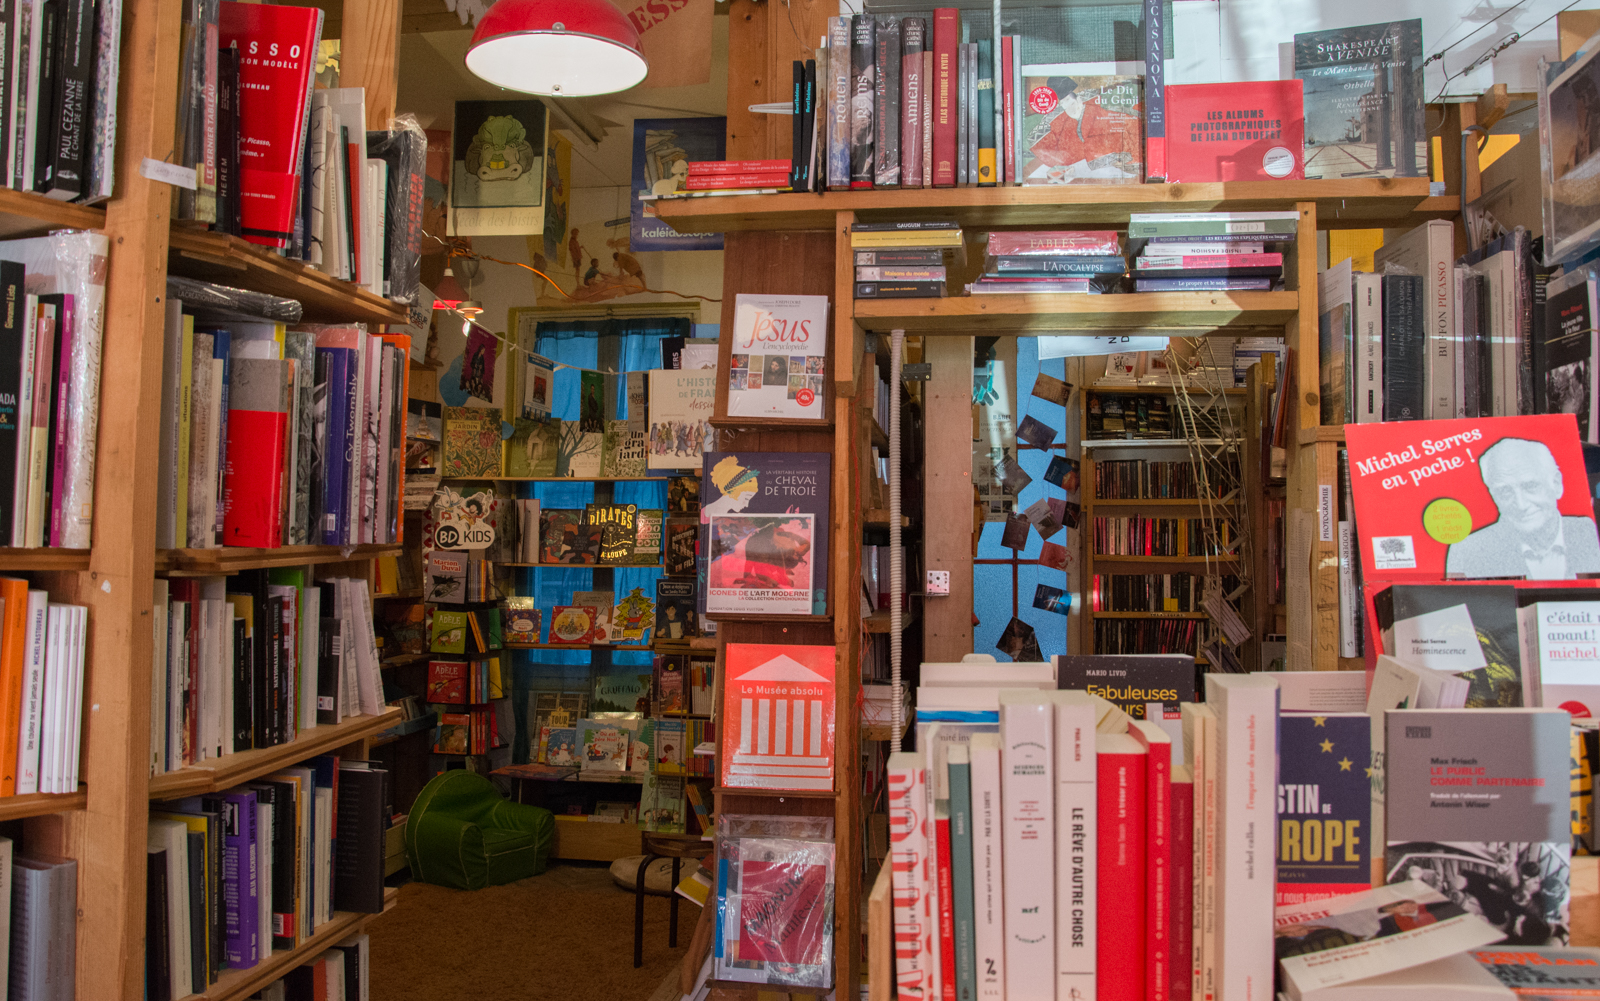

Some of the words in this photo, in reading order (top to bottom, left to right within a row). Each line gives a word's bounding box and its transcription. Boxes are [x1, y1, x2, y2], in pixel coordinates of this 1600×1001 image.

[626, 0, 690, 35] ESS
[1150, 6, 1161, 98] CASANOVA
[1317, 36, 1399, 53] SHAKESPEARE
[1334, 47, 1390, 60] VENISE
[1324, 64, 1367, 76] Marchand
[1380, 60, 1406, 70] Venise
[74, 80, 83, 100] TERRE
[940, 78, 948, 107] HISTORIQUE
[1100, 85, 1114, 96] Le
[1116, 84, 1134, 96] Dit
[1343, 81, 1375, 90] Othello
[62, 78, 76, 132] CEZANNE
[74, 102, 82, 111] LA
[206, 84, 215, 125] TABLEAU
[1094, 94, 1107, 106] du
[1111, 94, 1139, 107] Genji
[74, 112, 81, 122] DE
[940, 108, 948, 124] ATLAS
[1207, 111, 1223, 120] LES
[1226, 109, 1264, 120] ALBUMS
[1190, 120, 1282, 132] PHOTOGRAPHIQUES
[72, 124, 80, 150] CHANT
[1190, 132, 1204, 142] DE
[1206, 132, 1229, 142] JEAN
[1232, 130, 1282, 141] DUBUFFET
[60, 135, 72, 160] PAUL
[206, 126, 214, 166] DERNIER
[71, 152, 78, 160] LE
[206, 168, 213, 179] LE
[407, 173, 418, 251] ALMANACH
[488, 212, 506, 227] des
[508, 210, 540, 226] loisirs
[1030, 239, 1075, 248] FABLES
[1043, 262, 1104, 272] L'APOCALYPSE
[1438, 261, 1447, 308] PICASSO
[1406, 317, 1412, 326] OU
[743, 312, 811, 348] Jésus
[1438, 312, 1448, 357] BUFFON
[763, 342, 808, 352] L'encyclopédie
[677, 378, 716, 387] L'HISTO
[0, 393, 16, 406] ADA
[346, 374, 358, 439] Twombly
[689, 398, 715, 410] dessin
[346, 442, 354, 462] Cy
[1356, 445, 1421, 477] Michel
[1421, 428, 1482, 456] Serres
[1382, 474, 1407, 490] en
[1409, 455, 1464, 486] poche
[1466, 448, 1476, 463] !
[775, 476, 817, 485] CHEVAL
[765, 486, 779, 496] DE
[782, 486, 816, 496] TROIE
[590, 506, 632, 529] PIRATES
[1433, 512, 1462, 520] achetés
[439, 530, 458, 543] BD
[464, 530, 491, 542] KIDS
[1440, 532, 1460, 540] offert
[1387, 560, 1416, 569] Pommier
[438, 614, 461, 624] ADÈLE
[1547, 611, 1593, 624] c'était
[35, 609, 43, 644] PASTOUREAU
[1412, 647, 1466, 656] Hominescence
[1549, 647, 1600, 659] michel
[435, 666, 458, 675] ADÈLE
[601, 685, 640, 695] GRUFFALO
[741, 685, 752, 694] Le
[756, 685, 787, 694] Musée
[790, 687, 823, 696] absolu
[1087, 685, 1178, 700] Fabuleuses
[552, 715, 567, 723] TOUR
[1247, 715, 1256, 751] marchés
[1247, 753, 1256, 768] des
[1431, 767, 1443, 775] LE
[1446, 766, 1486, 775] PUBLIC
[1431, 778, 1473, 786] COMME
[1476, 778, 1545, 787] PARTENAIRE
[1246, 771, 1256, 810] l'emprise
[1276, 784, 1320, 814] STIN
[1322, 804, 1331, 814] DE
[1072, 808, 1083, 820] LE
[1072, 823, 1086, 852] RÊVE
[1246, 822, 1254, 848] callon
[1282, 820, 1360, 862] ROPE
[1246, 850, 1254, 880] michel
[1072, 856, 1084, 905] D'AUTRE
[744, 874, 804, 935] MAGNUM
[1022, 906, 1040, 914] nrf
[764, 894, 820, 954] Manifeste
[1277, 910, 1330, 926] DOSSE
[1072, 909, 1083, 948] CHOSE
